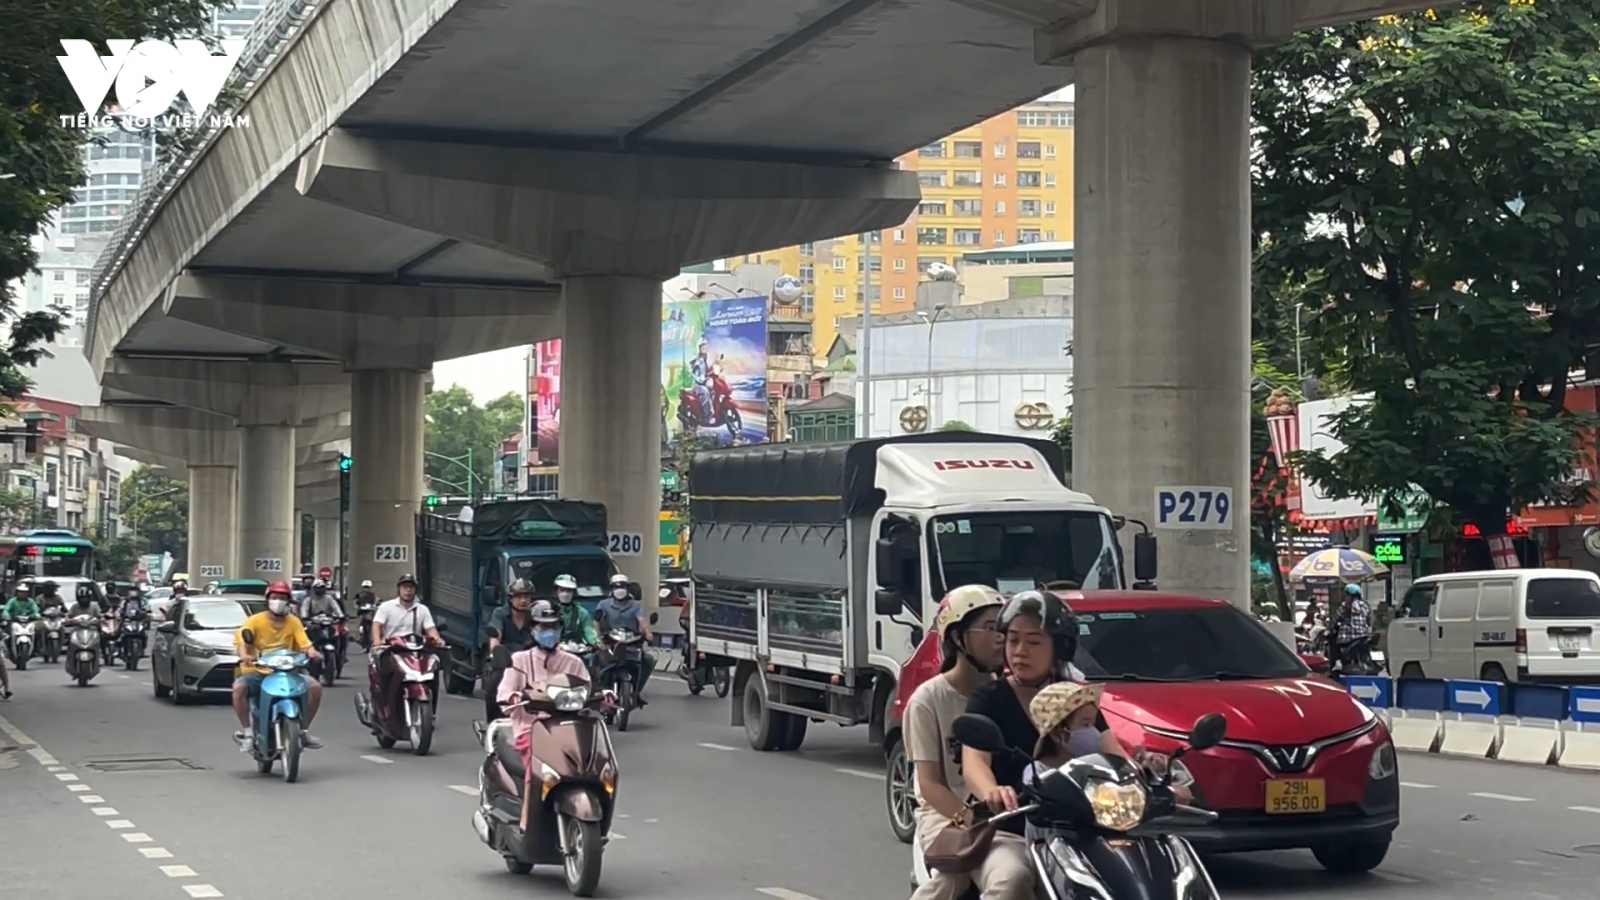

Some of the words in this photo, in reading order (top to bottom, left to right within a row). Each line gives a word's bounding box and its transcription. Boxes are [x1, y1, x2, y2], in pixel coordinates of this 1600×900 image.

[933, 459, 1035, 471] ISUZU
[1159, 490, 1229, 524] P279
[605, 534, 641, 553] 280
[376, 546, 407, 560] P281
[255, 560, 281, 570] P282
[1314, 558, 1335, 571] be
[1341, 558, 1365, 571] be
[201, 567, 223, 576] P283
[1284, 781, 1309, 795] 29H
[1273, 796, 1319, 811] 956.00
